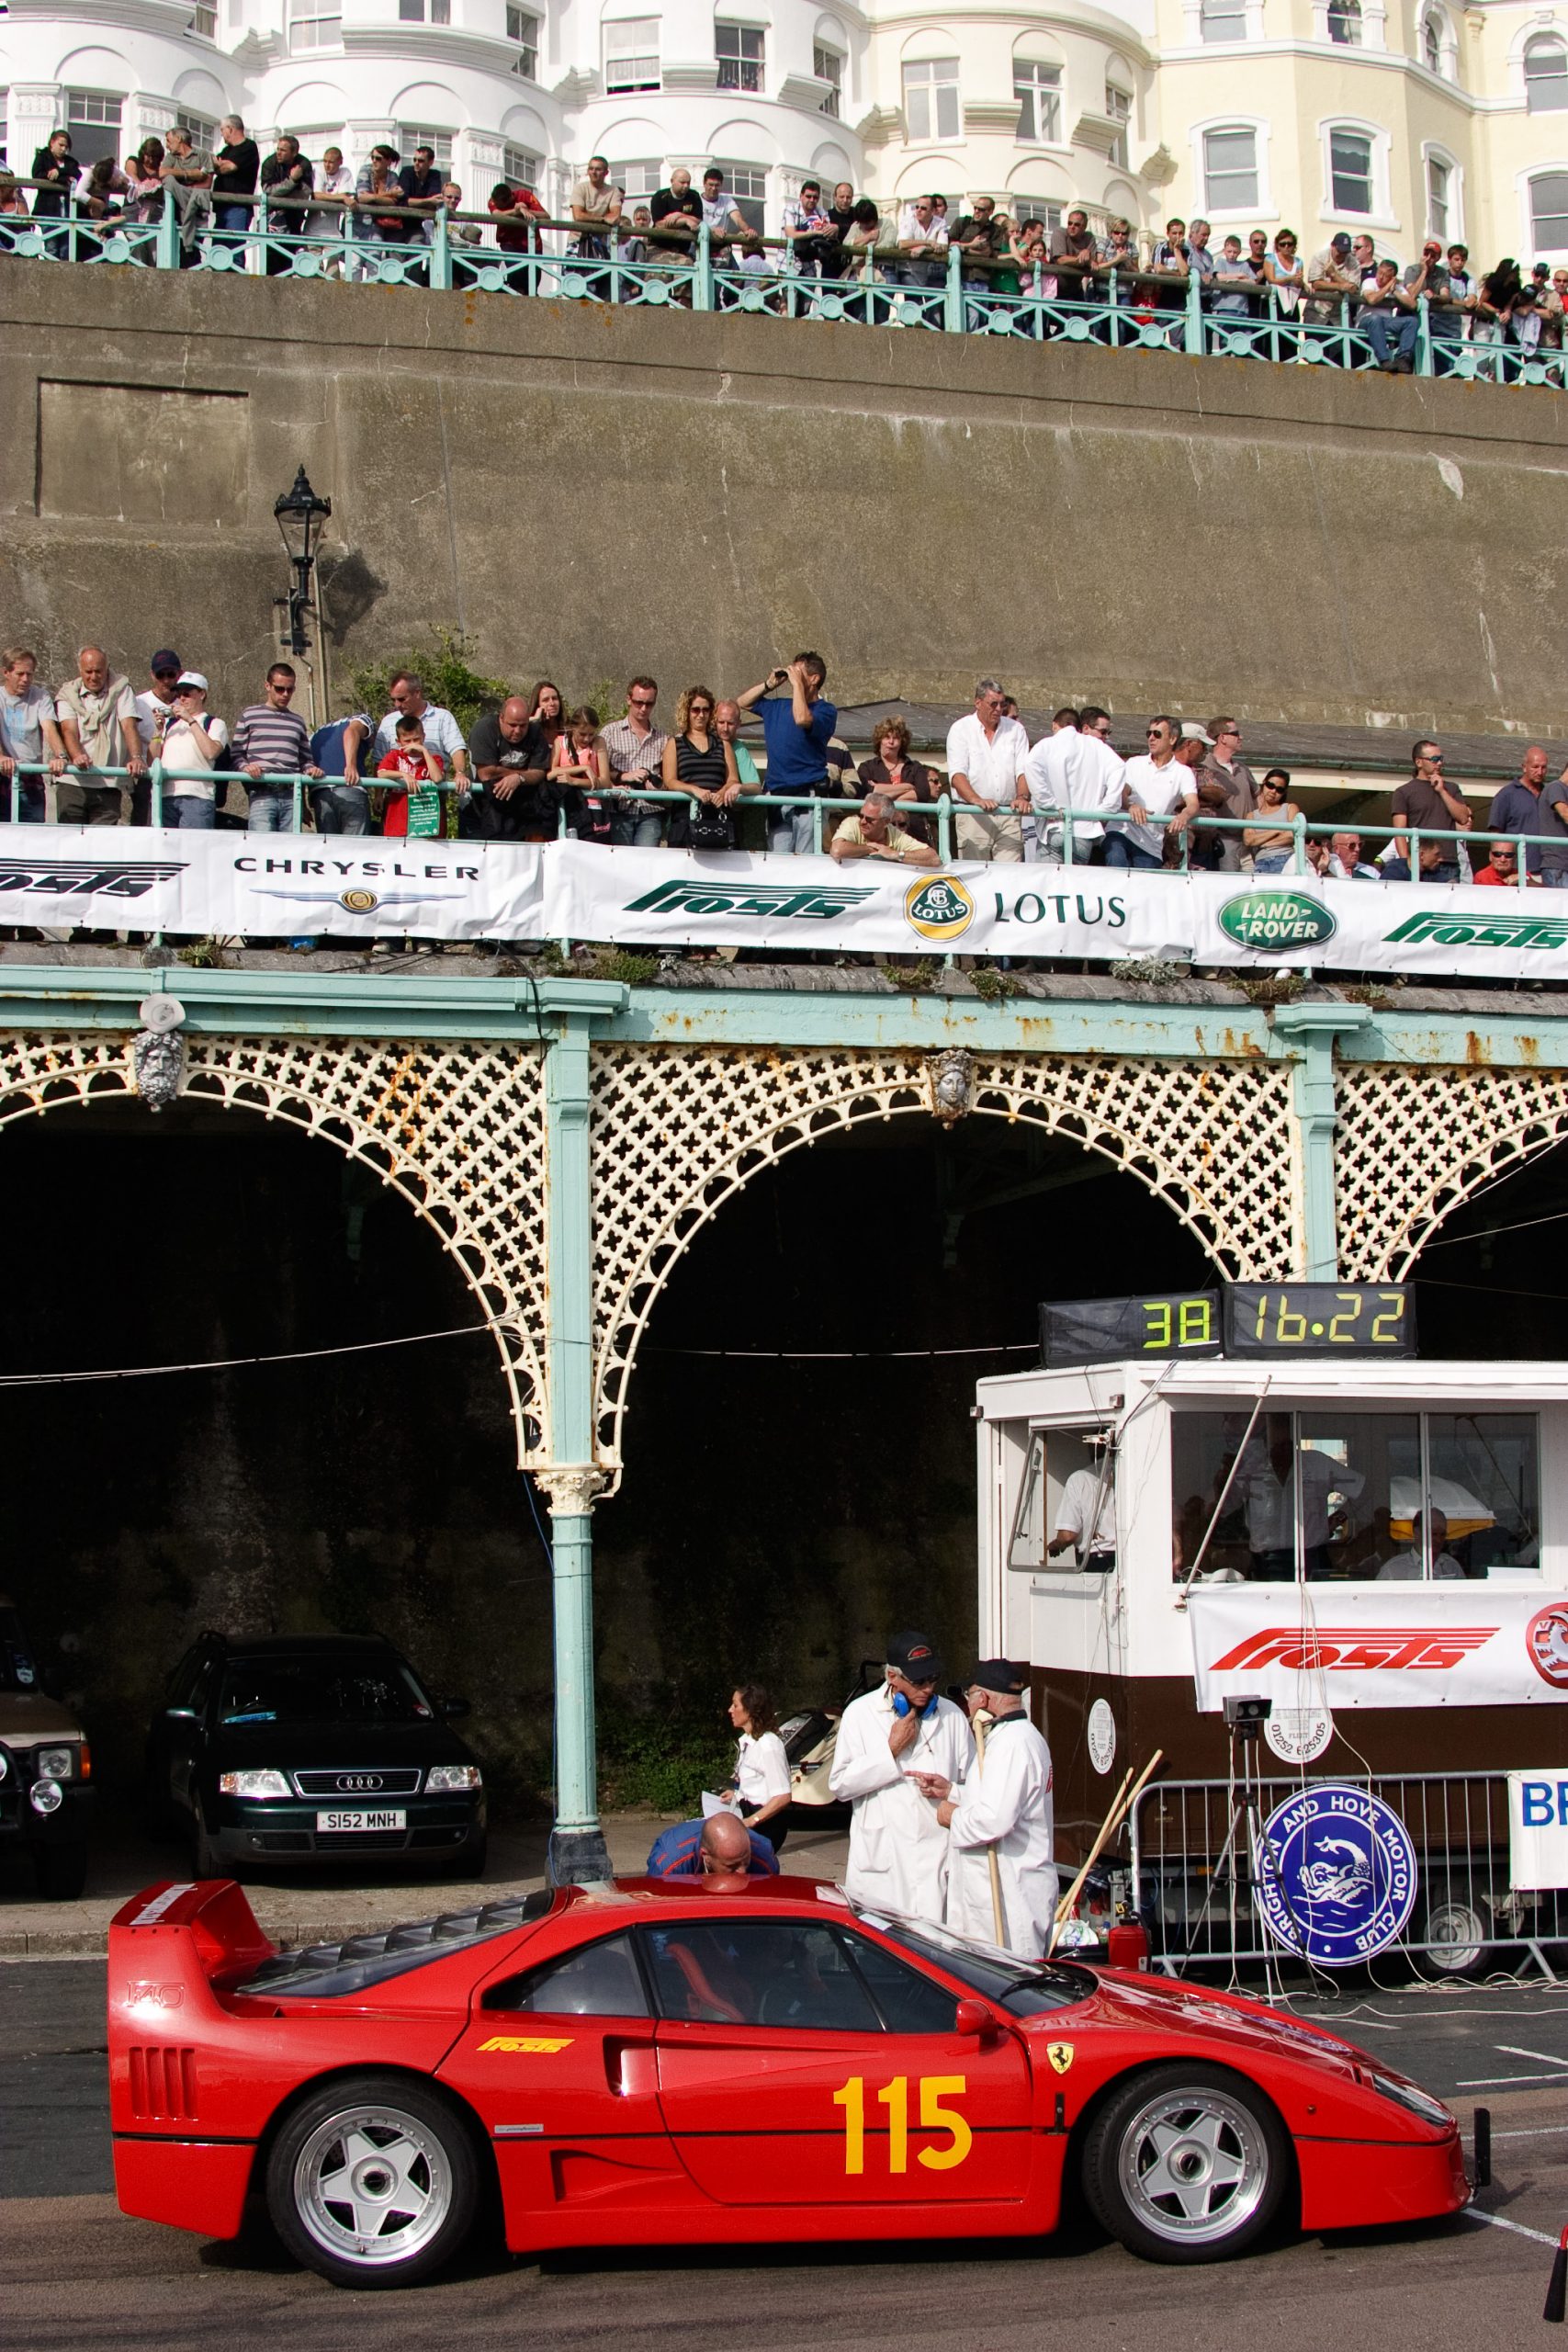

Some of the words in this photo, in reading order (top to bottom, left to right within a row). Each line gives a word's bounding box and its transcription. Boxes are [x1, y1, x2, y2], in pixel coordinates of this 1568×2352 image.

[0, 858, 190, 898] osts
[234, 857, 479, 881] CHRYSLER
[913, 903, 965, 920] LOTUS
[995, 891, 1125, 928] LOTUS
[1242, 901, 1300, 920] LAND
[1247, 921, 1320, 938] ROVER
[1142, 1299, 1211, 1349] 38
[1256, 1293, 1404, 1342] 16.22
[1271, 1724, 1293, 1754] 01252
[367, 1813, 397, 1827] MNH
[1282, 1799, 1319, 1833] AND
[1331, 1795, 1382, 1826] HOVE
[1382, 1828, 1407, 1902] MOTOR
[1355, 1912, 1395, 1951] CLUB
[127, 1981, 186, 2008] F40
[832, 2075, 974, 2175] 115
